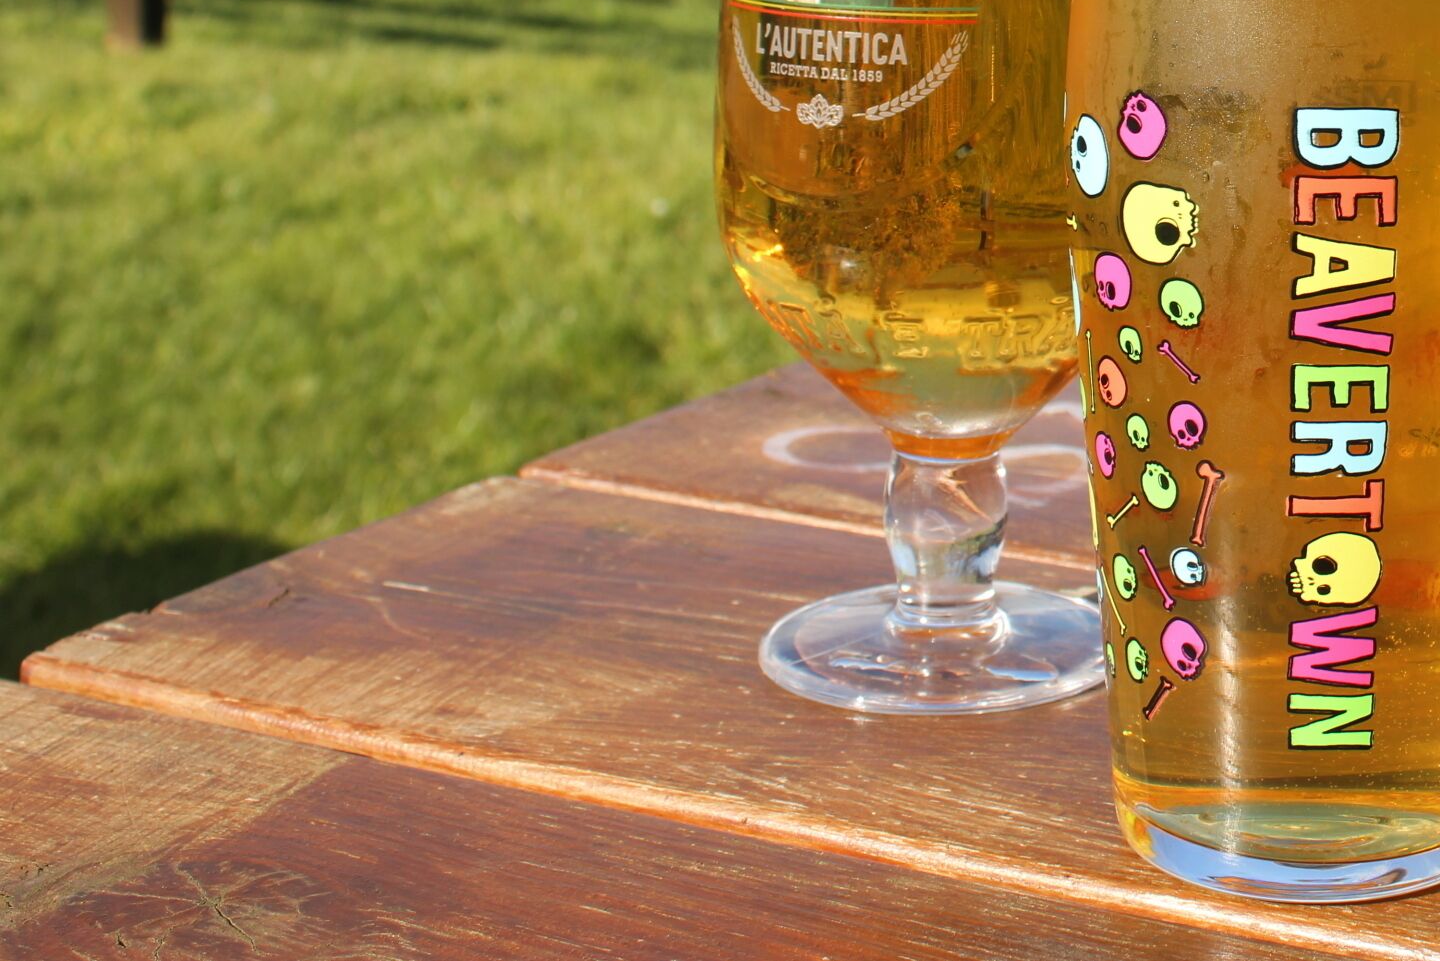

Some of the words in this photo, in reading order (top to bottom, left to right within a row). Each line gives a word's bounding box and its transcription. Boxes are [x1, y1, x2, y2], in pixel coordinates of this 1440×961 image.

[770, 62, 818, 78] RICETTA
[821, 67, 849, 81] DAL
[852, 69, 883, 82] 1859
